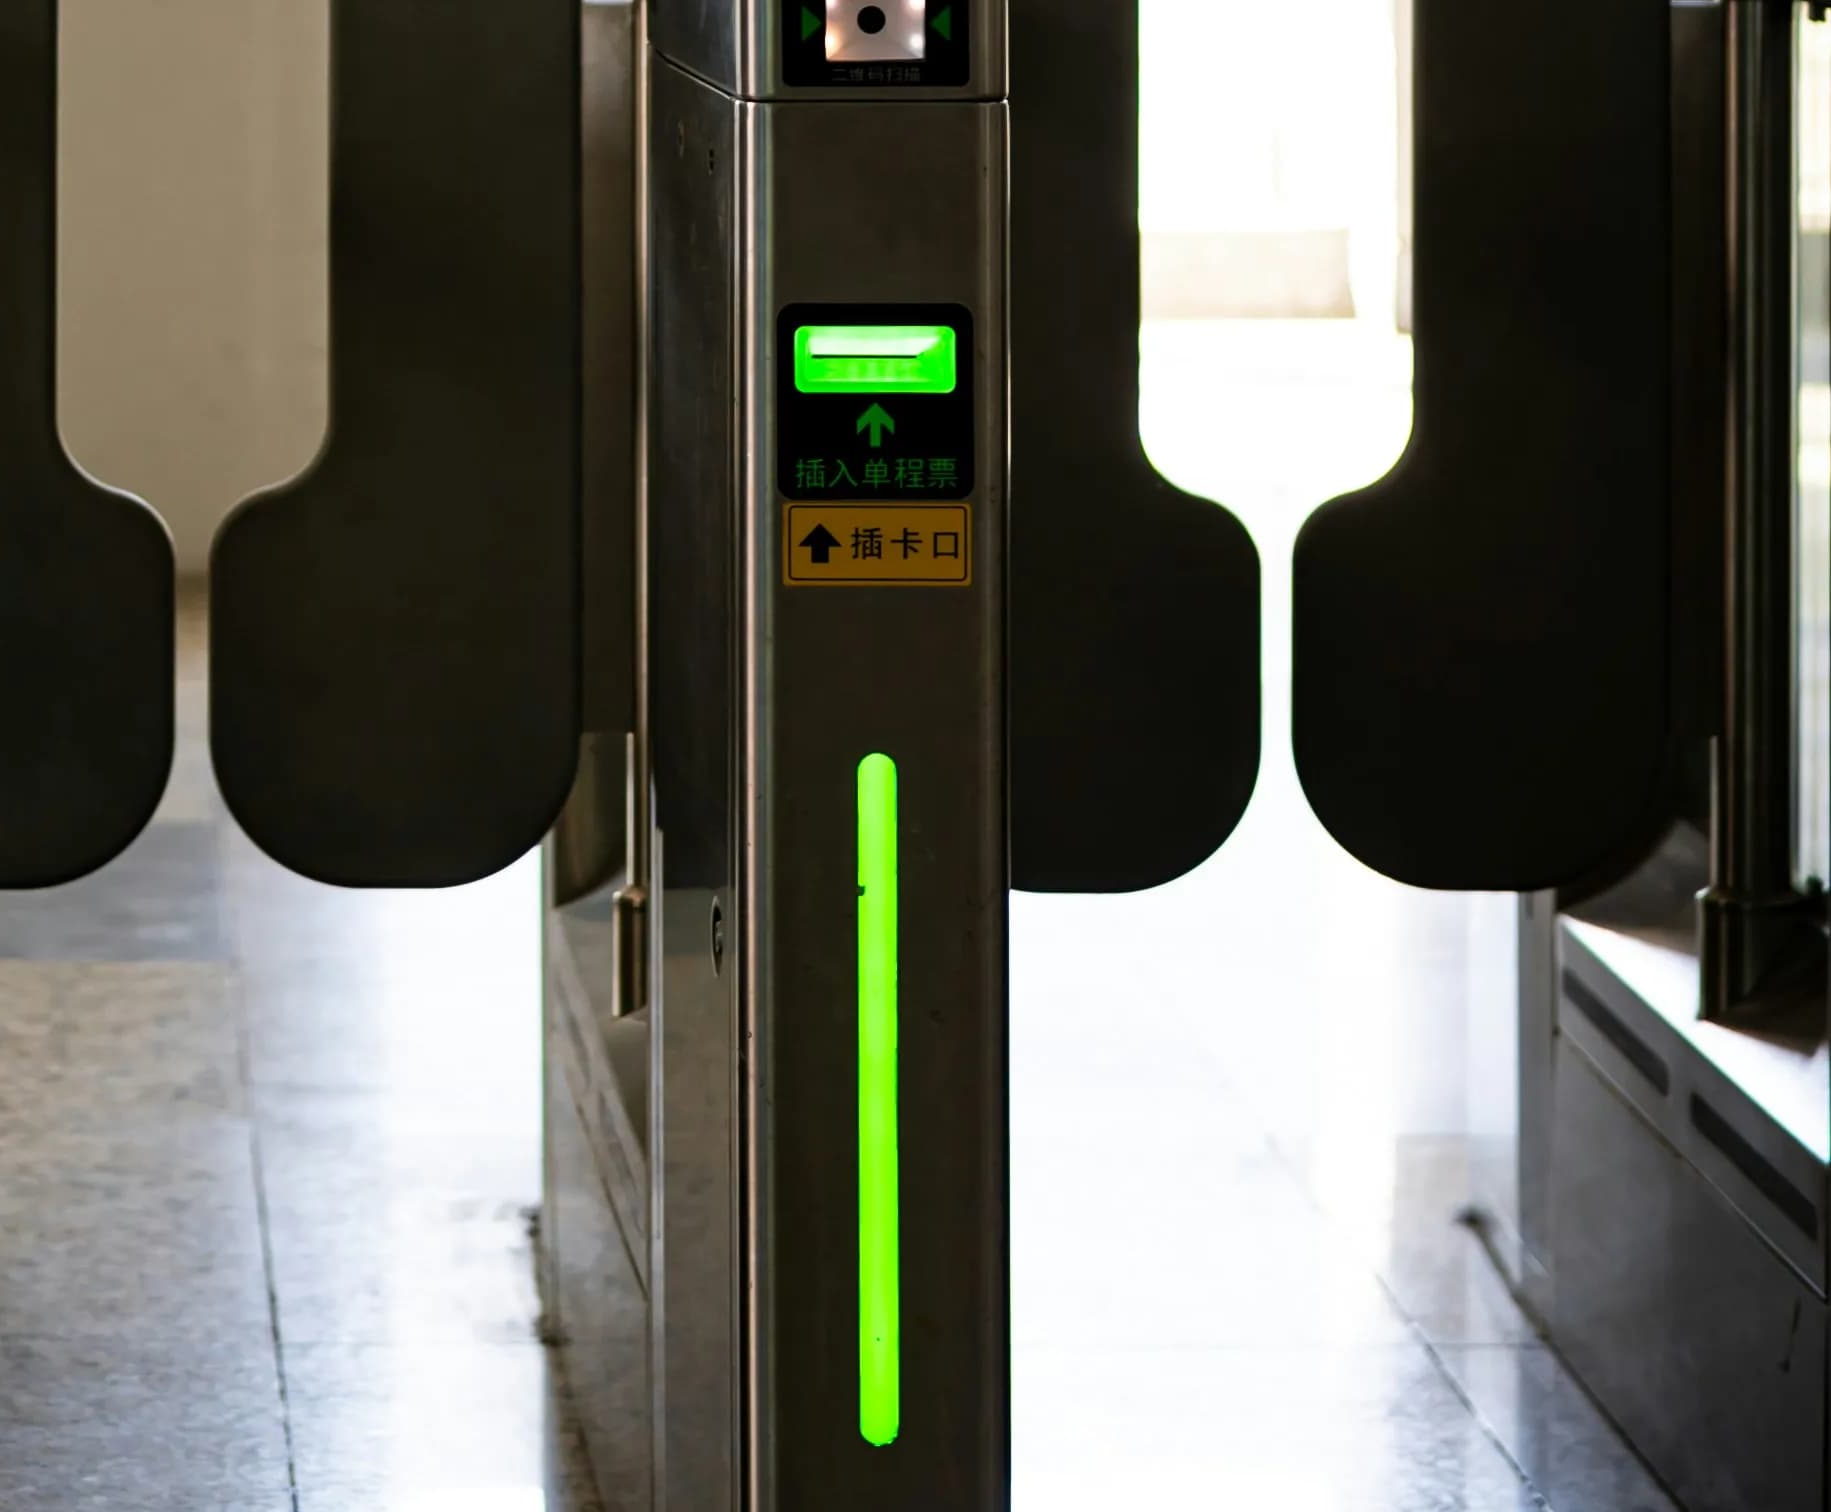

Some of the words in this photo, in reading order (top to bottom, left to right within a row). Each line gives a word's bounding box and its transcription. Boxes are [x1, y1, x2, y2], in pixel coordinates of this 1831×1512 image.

[796, 458, 958, 489] 插入单程票
[851, 527, 959, 560] 插卡口
